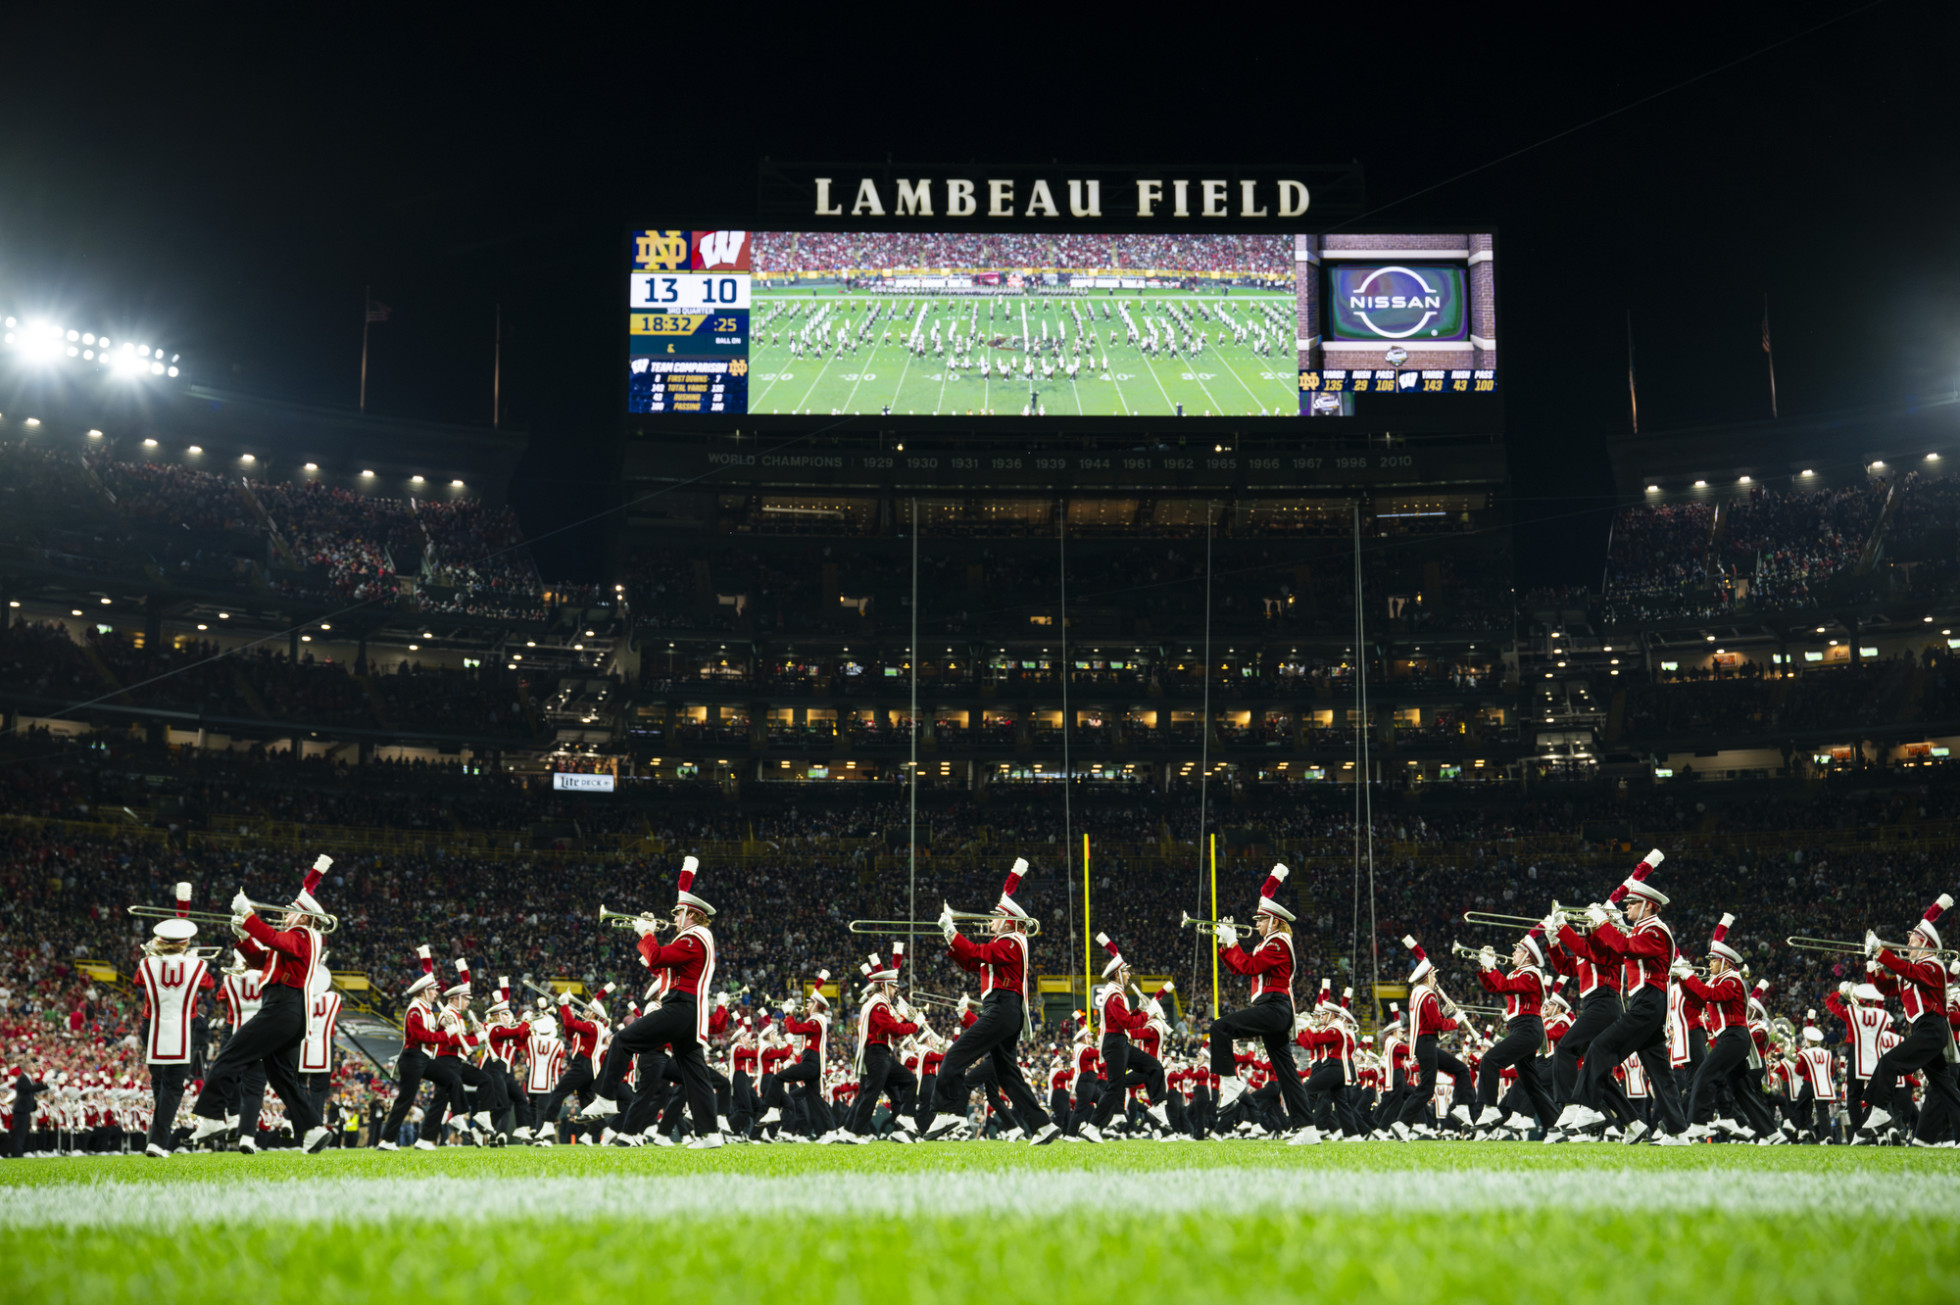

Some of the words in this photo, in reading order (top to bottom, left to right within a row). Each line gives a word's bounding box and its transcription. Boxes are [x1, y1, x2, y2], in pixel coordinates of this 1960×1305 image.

[814, 178, 1102, 217] LAMBEAU
[1136, 179, 1310, 217] FIELD
[699, 230, 746, 270] W
[644, 278, 678, 303] 13
[702, 278, 737, 303] 10
[1350, 296, 1440, 309] NISSAN
[642, 316, 692, 331] 18:32
[651, 362, 674, 373] TEAM
[673, 362, 728, 373] COMPARISON
[1323, 370, 1346, 379] YARDS
[1352, 370, 1372, 379] RUSH
[1375, 370, 1395, 379] PASS
[1422, 370, 1445, 379] YARDS
[1451, 370, 1471, 379] RUSH
[1474, 370, 1494, 379] PASS
[668, 384, 686, 392] TOTAL
[1323, 380, 1344, 391] 135
[1354, 380, 1368, 391] 29
[1375, 380, 1395, 391] 106
[1423, 380, 1443, 391] 143
[1453, 380, 1468, 391] 43
[1474, 380, 1494, 391] 100
[673, 402, 701, 411] PASSING
[708, 453, 755, 466] WORLD
[762, 455, 842, 468] CHAMPIONS
[863, 457, 893, 469] 1929
[907, 457, 938, 469] 1930
[951, 458, 979, 469] 1931
[992, 458, 1022, 469] 1936
[1036, 458, 1066, 469] 1939
[1079, 458, 1110, 469] 1944
[1123, 458, 1150, 469] 1961
[1163, 458, 1194, 469] 1962
[1206, 458, 1236, 469] 1965
[1249, 458, 1280, 469] 1966
[1293, 458, 1322, 469] 1967
[1336, 457, 1367, 468] 1996
[1380, 456, 1412, 467] 2010
[561, 775, 579, 788] Lite
[160, 960, 185, 990] W
[1862, 1010, 1877, 1028] W
[537, 1040, 550, 1055] W
[1813, 1051, 1825, 1065] W
